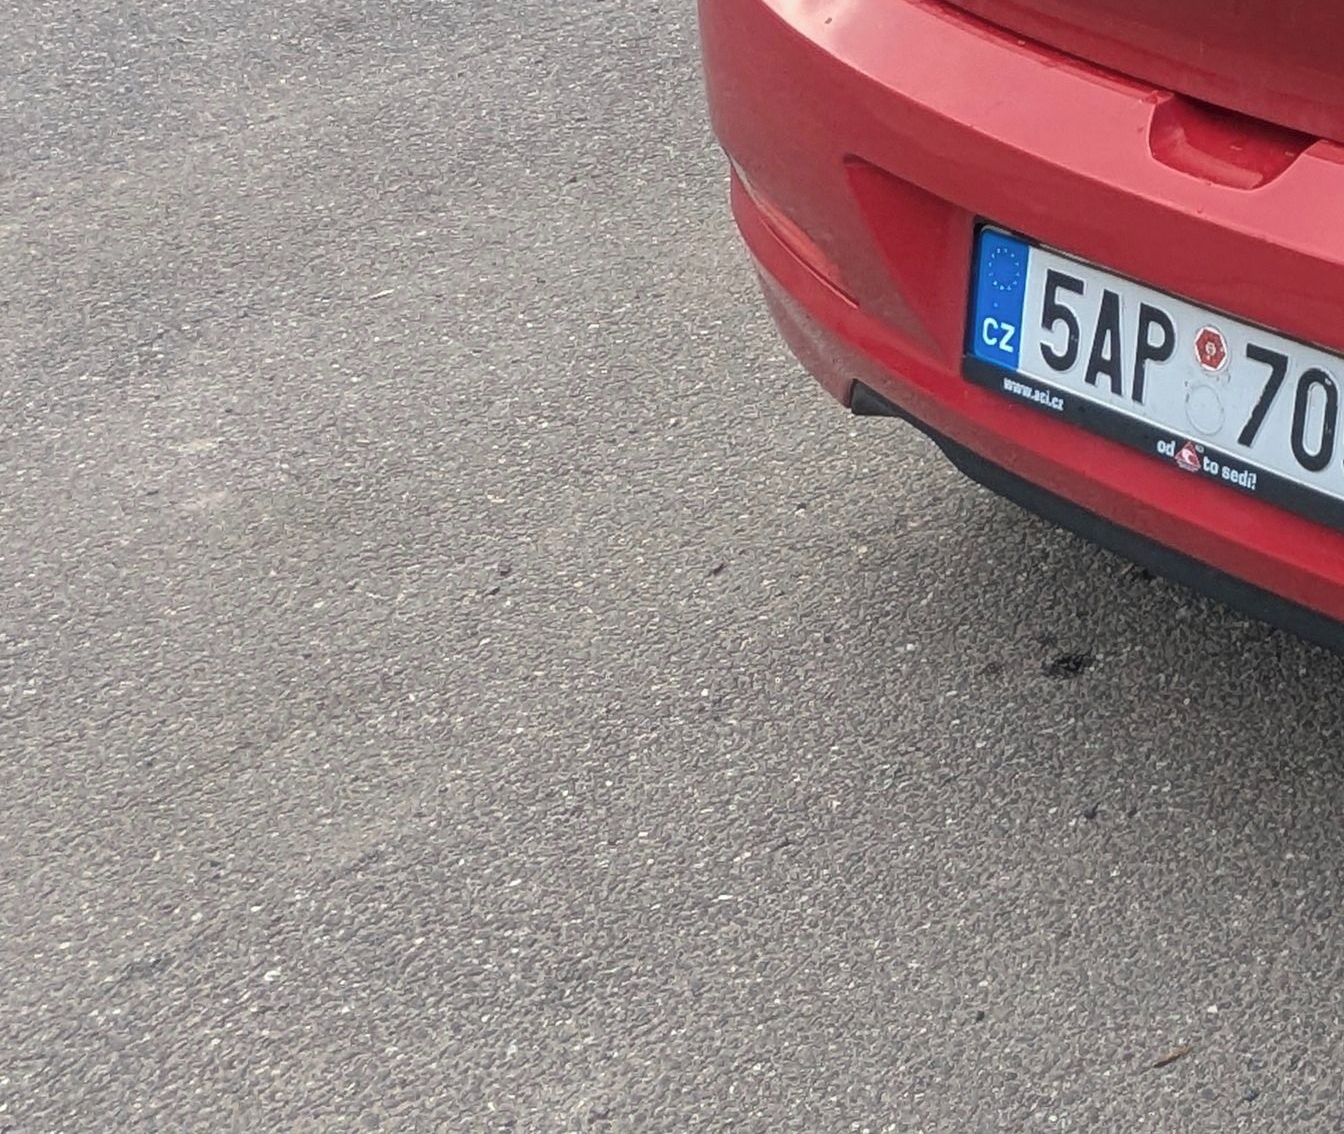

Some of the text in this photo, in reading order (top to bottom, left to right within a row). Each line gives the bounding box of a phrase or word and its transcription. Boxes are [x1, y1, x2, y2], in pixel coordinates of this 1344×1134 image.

[981, 316, 1015, 353] CZ
[1038, 268, 1176, 404] 5AP
[1003, 377, 1064, 411] www.aci.cz
[1156, 440, 1176, 458] od
[1203, 456, 1219, 475] to
